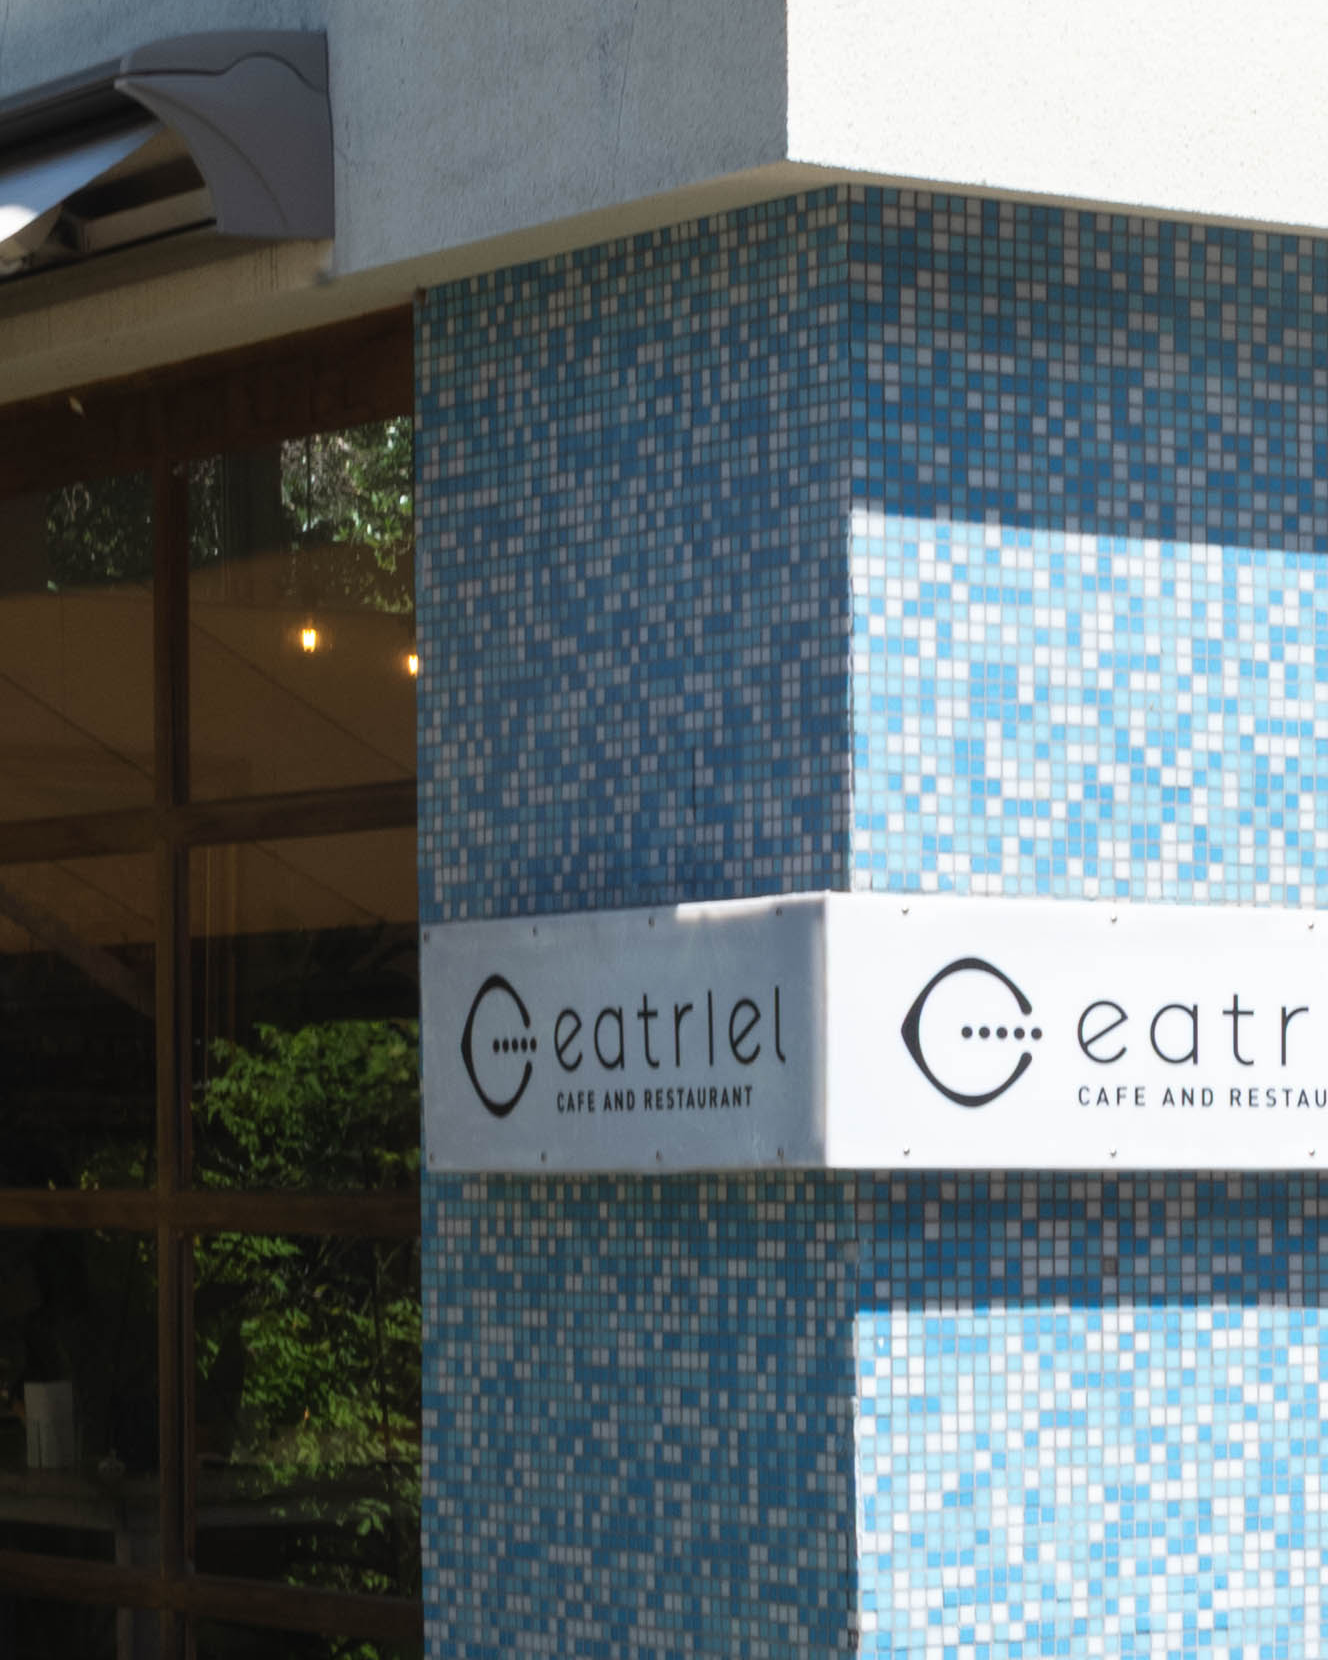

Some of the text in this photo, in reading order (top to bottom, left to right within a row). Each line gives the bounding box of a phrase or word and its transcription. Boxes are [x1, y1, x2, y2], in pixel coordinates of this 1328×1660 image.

[556, 1084, 753, 1114] CAFE AND RESTAURANT
[1077, 1086, 1147, 1108] CAFE
[1161, 1087, 1215, 1109] AND
